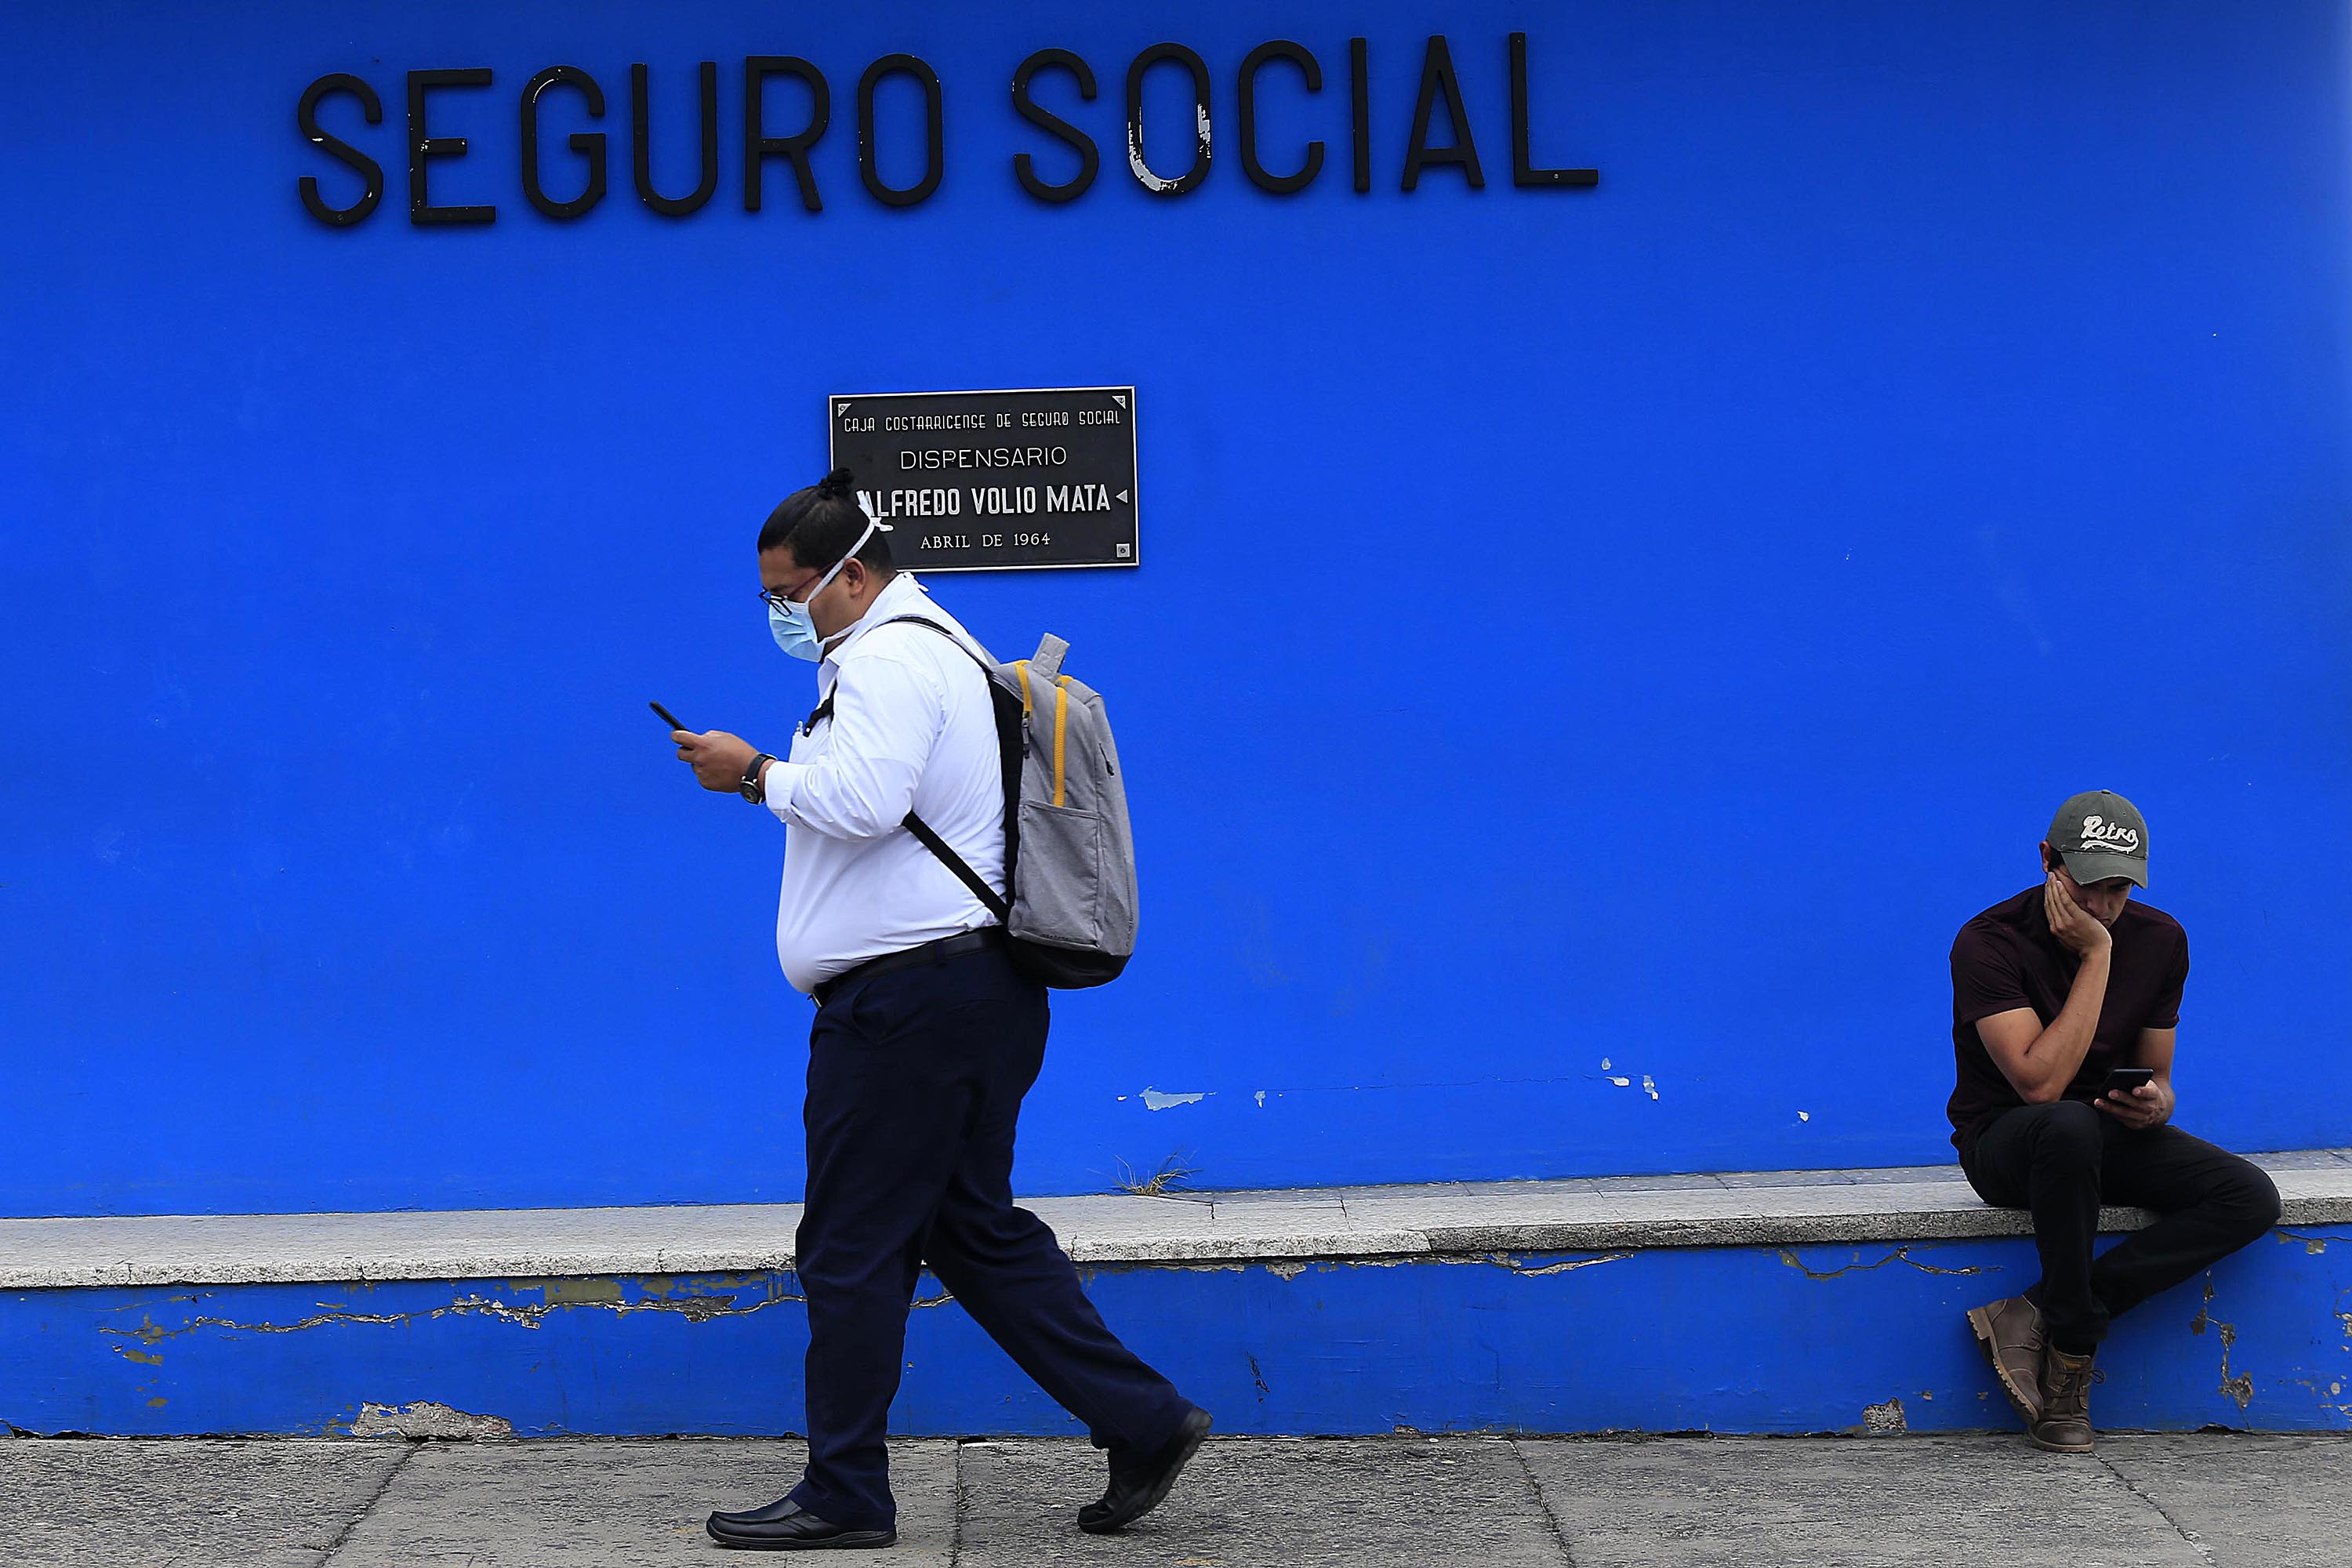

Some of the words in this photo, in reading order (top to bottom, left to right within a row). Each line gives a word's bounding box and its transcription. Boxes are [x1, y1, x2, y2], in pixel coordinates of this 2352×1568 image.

[296, 53, 945, 232] SEGURO
[1009, 32, 1599, 209] SOCIAL
[844, 417, 876, 432] CAJA
[885, 414, 986, 431] COSTARRICENSE
[996, 413, 1011, 428] DE
[1022, 412, 1069, 427] SEGURO
[1079, 410, 1121, 425] SOCIAL
[900, 446, 1067, 470] DISPENSARIO
[971, 486, 1036, 515] VOLIO
[1046, 484, 1111, 513] MATA
[920, 535, 971, 550] ABRIL
[982, 534, 1003, 547] DE
[1014, 532, 1051, 546] 1964
[2080, 815, 2140, 847] Retro
